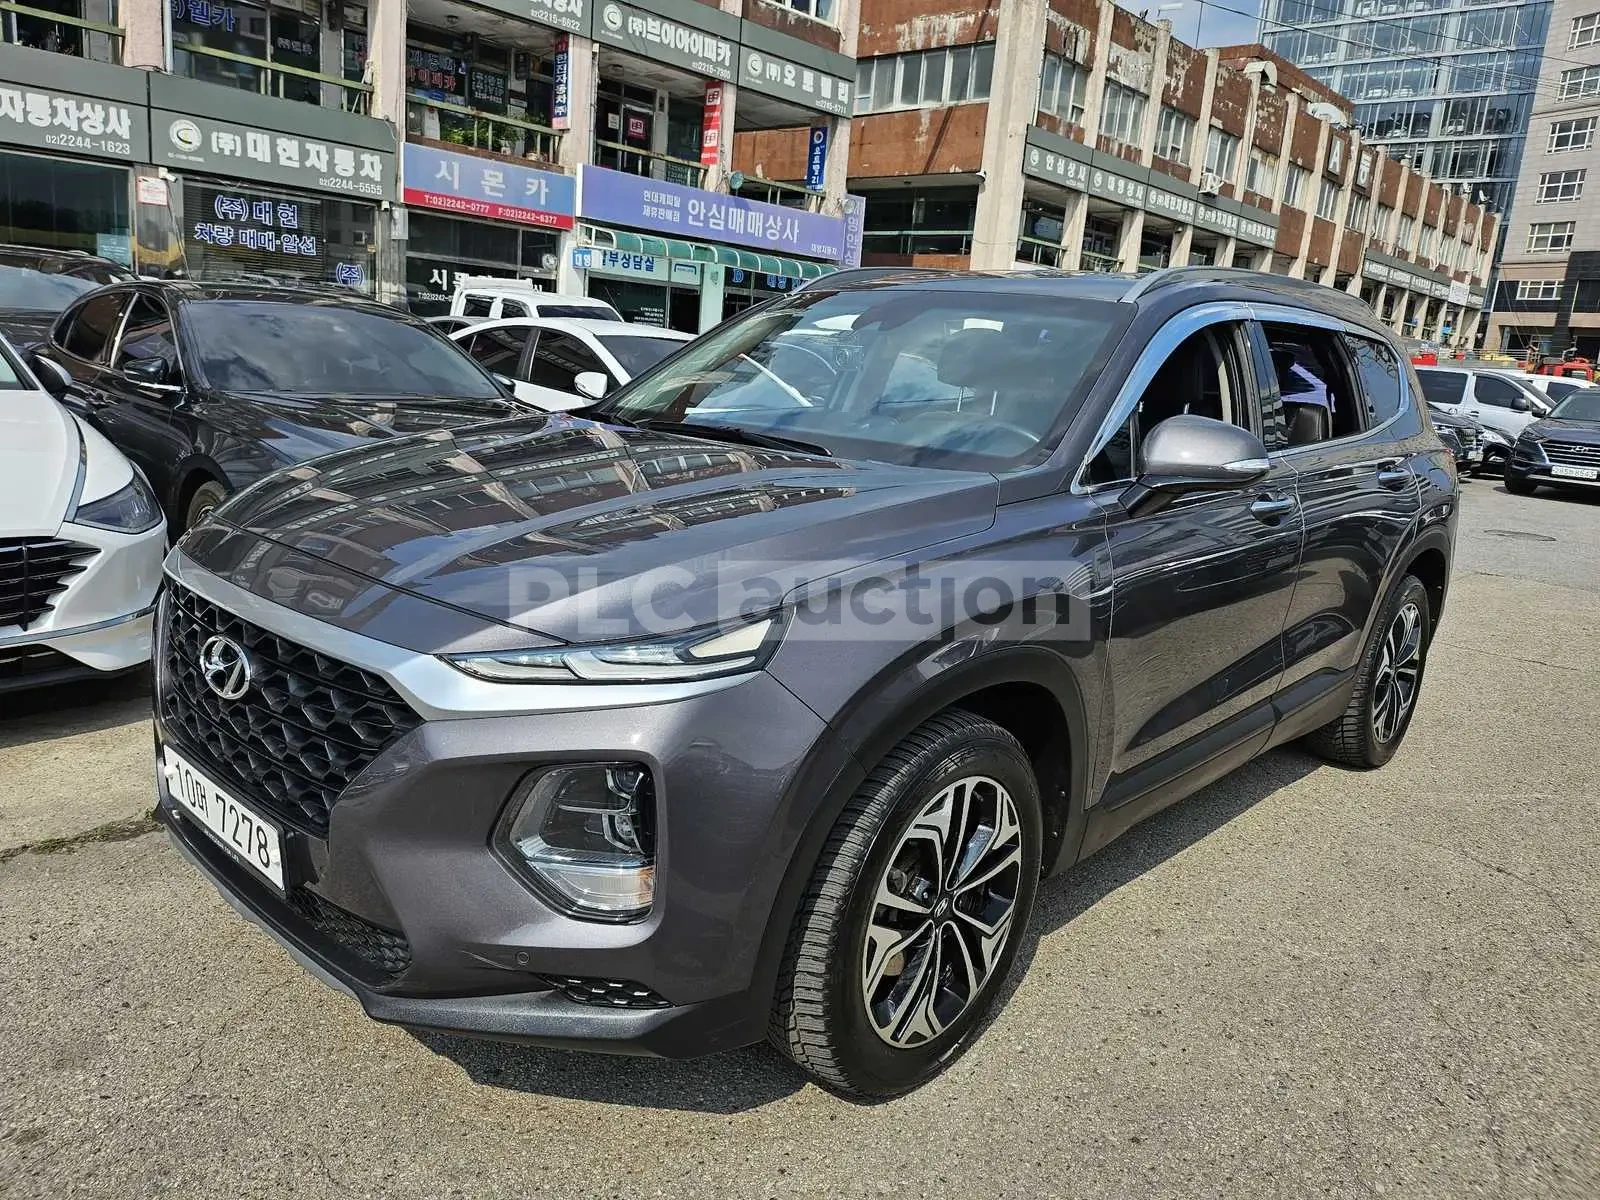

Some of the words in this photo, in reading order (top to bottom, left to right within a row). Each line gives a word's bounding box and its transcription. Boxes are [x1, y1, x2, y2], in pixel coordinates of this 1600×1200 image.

[46, 134, 131, 155] 02)2244-1623
[319, 177, 383, 195] 02)2244-5555
[424, 194, 490, 213] T:02)2242-0777
[643, 190, 681, 208] 현대캐피탈
[687, 199, 800, 244] 안심매매상사
[194, 222, 234, 246] 차량
[216, 793, 270, 868] 7278
